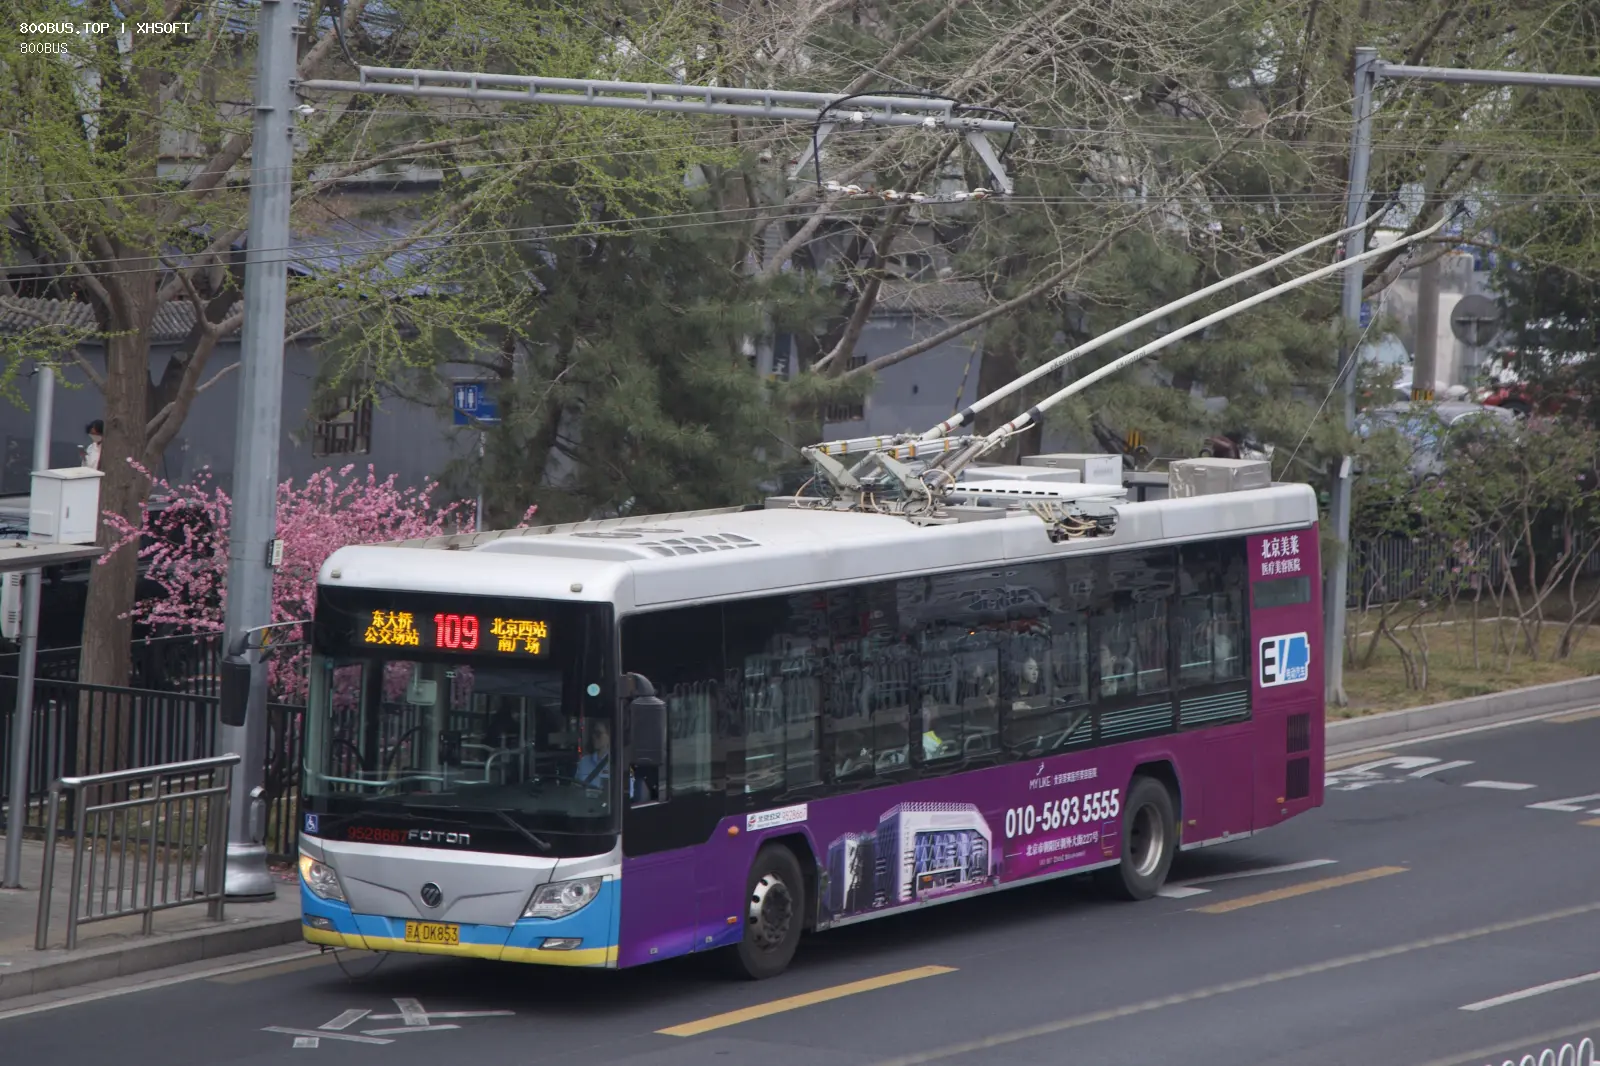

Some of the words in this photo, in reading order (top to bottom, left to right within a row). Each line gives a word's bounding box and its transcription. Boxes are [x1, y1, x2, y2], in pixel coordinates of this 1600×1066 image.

[1261, 534, 1300, 559] 北京美莱
[1261, 557, 1301, 576] 医疗美容医院
[372, 610, 413, 629] 东大桥
[490, 617, 547, 638] 北京西站
[364, 626, 419, 646] 公交场站
[433, 613, 478, 650] 109
[497, 635, 541, 655] 南广场
[1081, 788, 1120, 823] 5555
[347, 826, 408, 842] 9528667
[408, 829, 470, 845] FOTON
